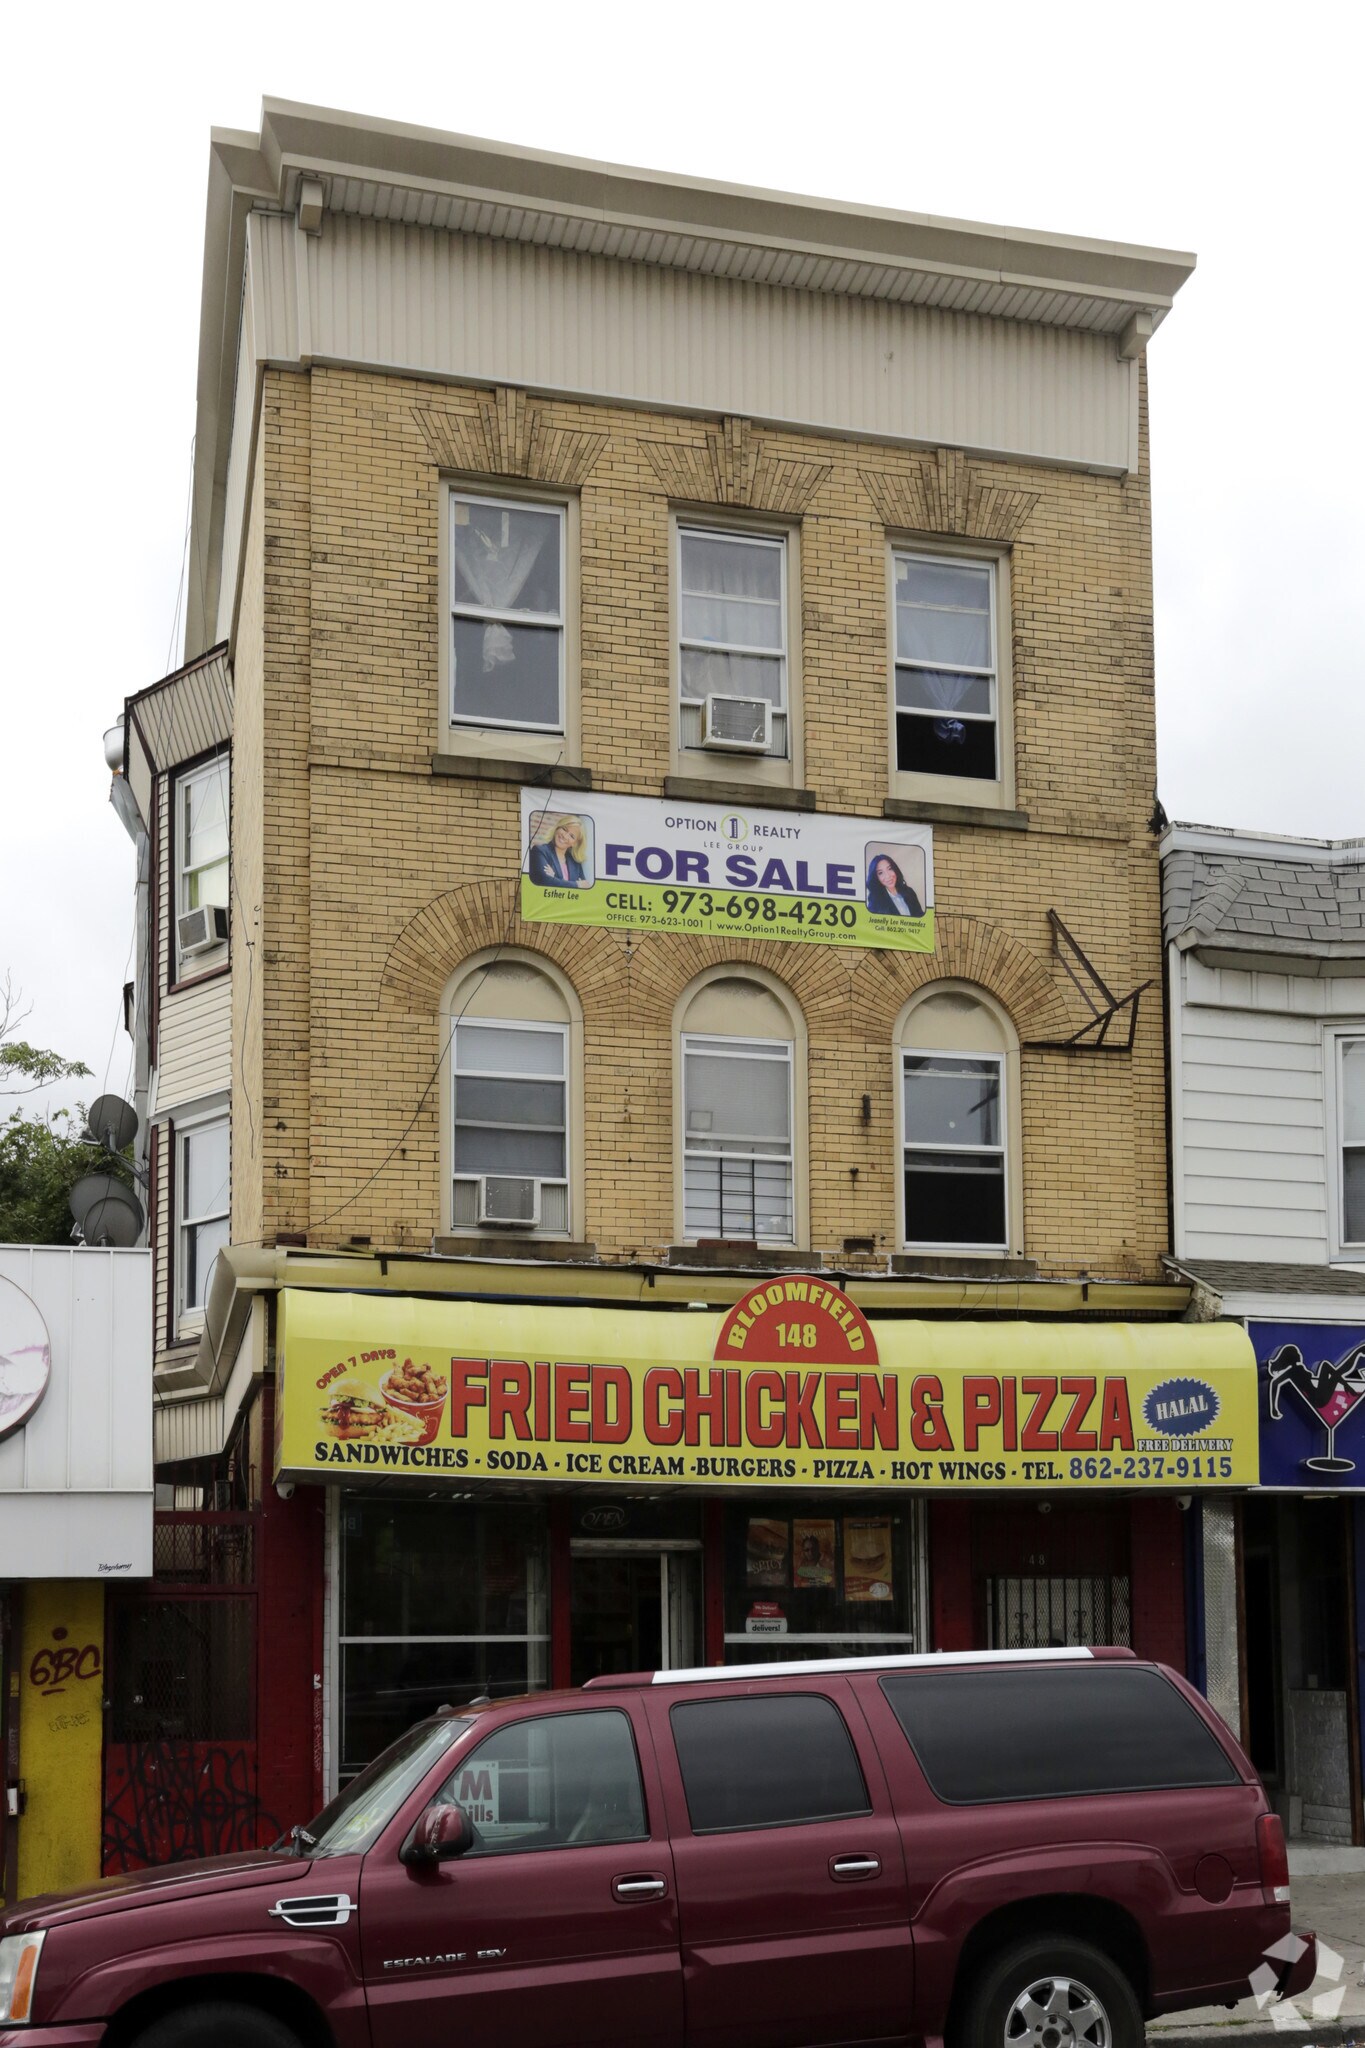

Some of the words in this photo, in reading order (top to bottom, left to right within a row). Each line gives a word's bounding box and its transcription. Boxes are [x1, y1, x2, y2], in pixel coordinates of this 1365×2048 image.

[664, 816, 718, 834] OPTION
[753, 824, 801, 841] REALTY
[703, 840, 721, 850] LEE
[727, 842, 764, 853] GROUP
[604, 844, 710, 884] FOR
[725, 857, 857, 897] SALE
[543, 888, 564, 899] Esther
[565, 891, 579, 901] Lee
[605, 892, 652, 911] CELL:
[662, 890, 857, 928] 973-698-4230
[606, 913, 637, 923] OFFICE:
[640, 915, 704, 928] 973-623-1001
[716, 923, 857, 941] www.Option1RealtyGroup.com
[899, 919, 926, 928] Hernandez
[727, 1281, 866, 1352] BLOOMFIELD
[775, 1323, 818, 1349] 148
[315, 1362, 349, 1391] OPEN
[347, 1356, 358, 1367] 7
[361, 1348, 397, 1364] DAYS
[450, 1356, 633, 1444] FRIED
[643, 1366, 899, 1451] CHICKEN
[910, 1374, 955, 1452] &
[962, 1375, 1135, 1453] PIZZA
[1155, 1395, 1208, 1421] HALAL
[1137, 1438, 1170, 1452] FREE
[1171, 1438, 1234, 1452] DELIVERY
[314, 1442, 469, 1469] SANDWICHES
[487, 1450, 548, 1472] SODA
[566, 1453, 603, 1473] ICE
[608, 1455, 685, 1476] CREAM
[813, 1459, 874, 1480] PIZZA
[891, 1460, 933, 1480] HOT
[937, 1461, 1007, 1482] WINGS
[1024, 1462, 1063, 1480] TEL.
[1069, 1457, 1233, 1480] 862-237-9115
[581, 1509, 624, 1526] OPEN
[751, 1624, 781, 1632] delivers!
[383, 1951, 467, 1970] ESCALADE
[476, 1947, 507, 1961] ESV
